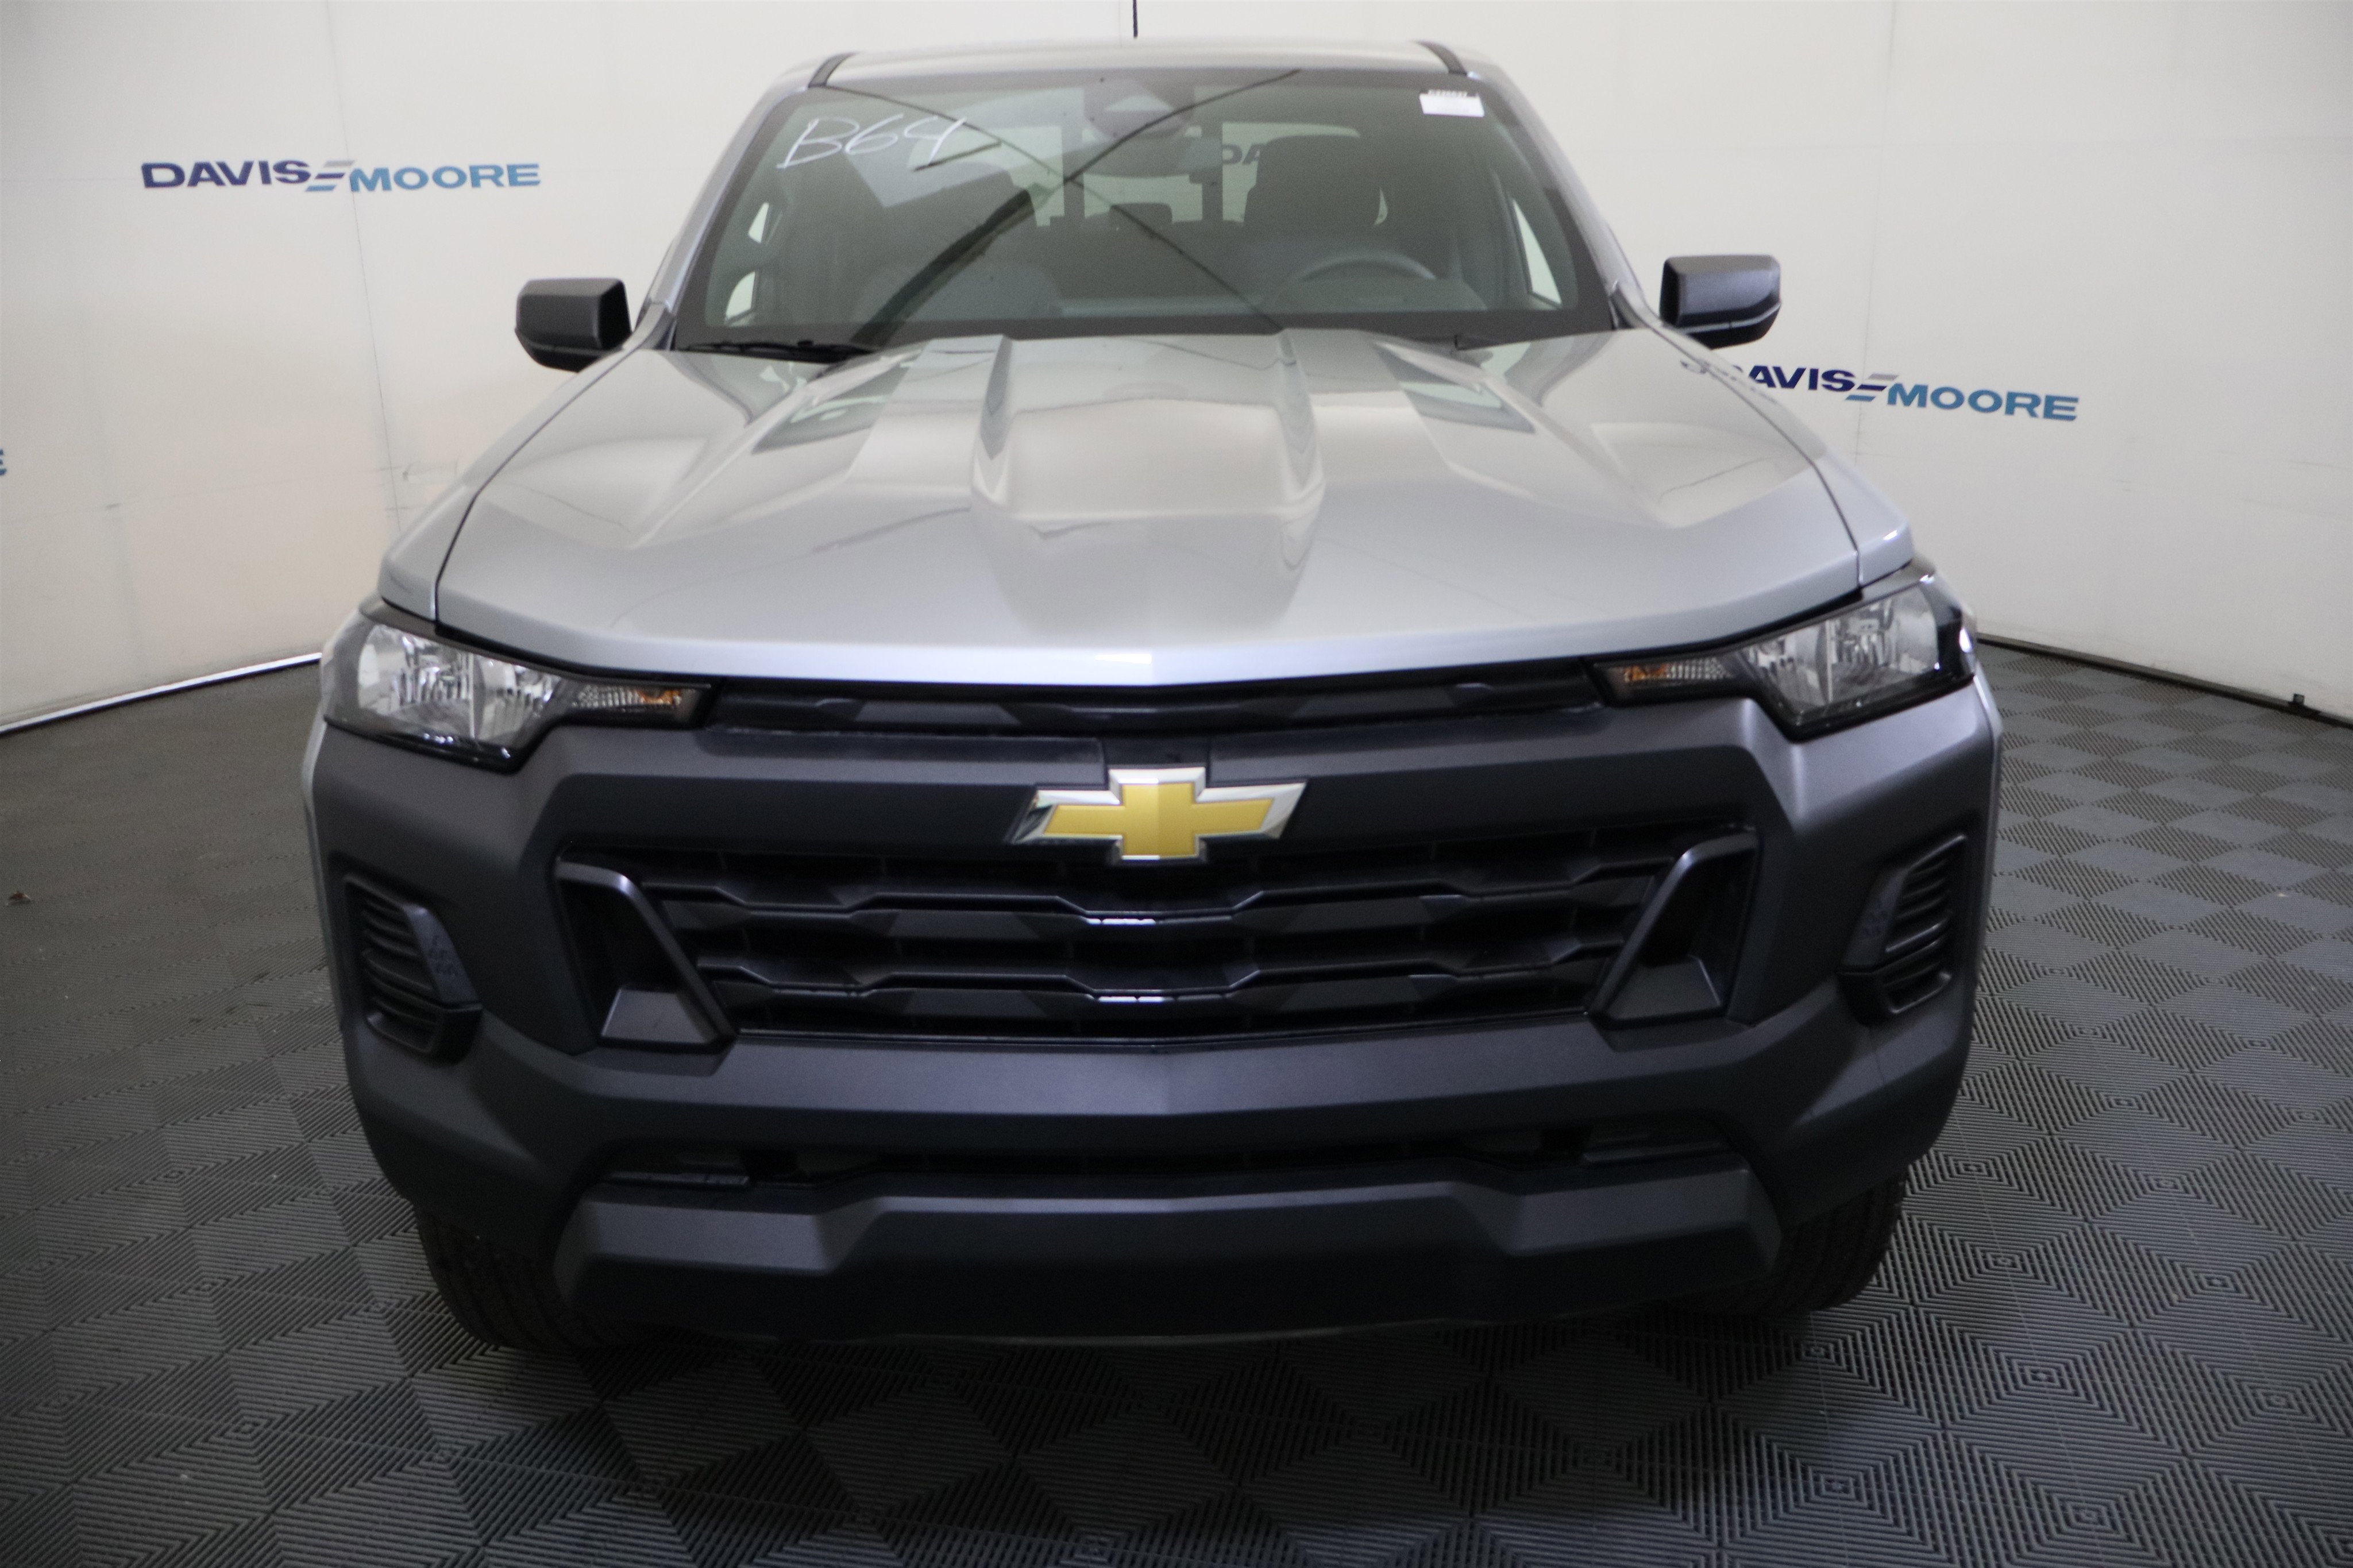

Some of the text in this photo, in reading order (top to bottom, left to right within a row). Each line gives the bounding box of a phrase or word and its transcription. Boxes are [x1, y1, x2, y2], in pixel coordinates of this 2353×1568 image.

[141, 160, 541, 192] DAVIS MOORE
[1733, 364, 2080, 422] AVIS MOORE
